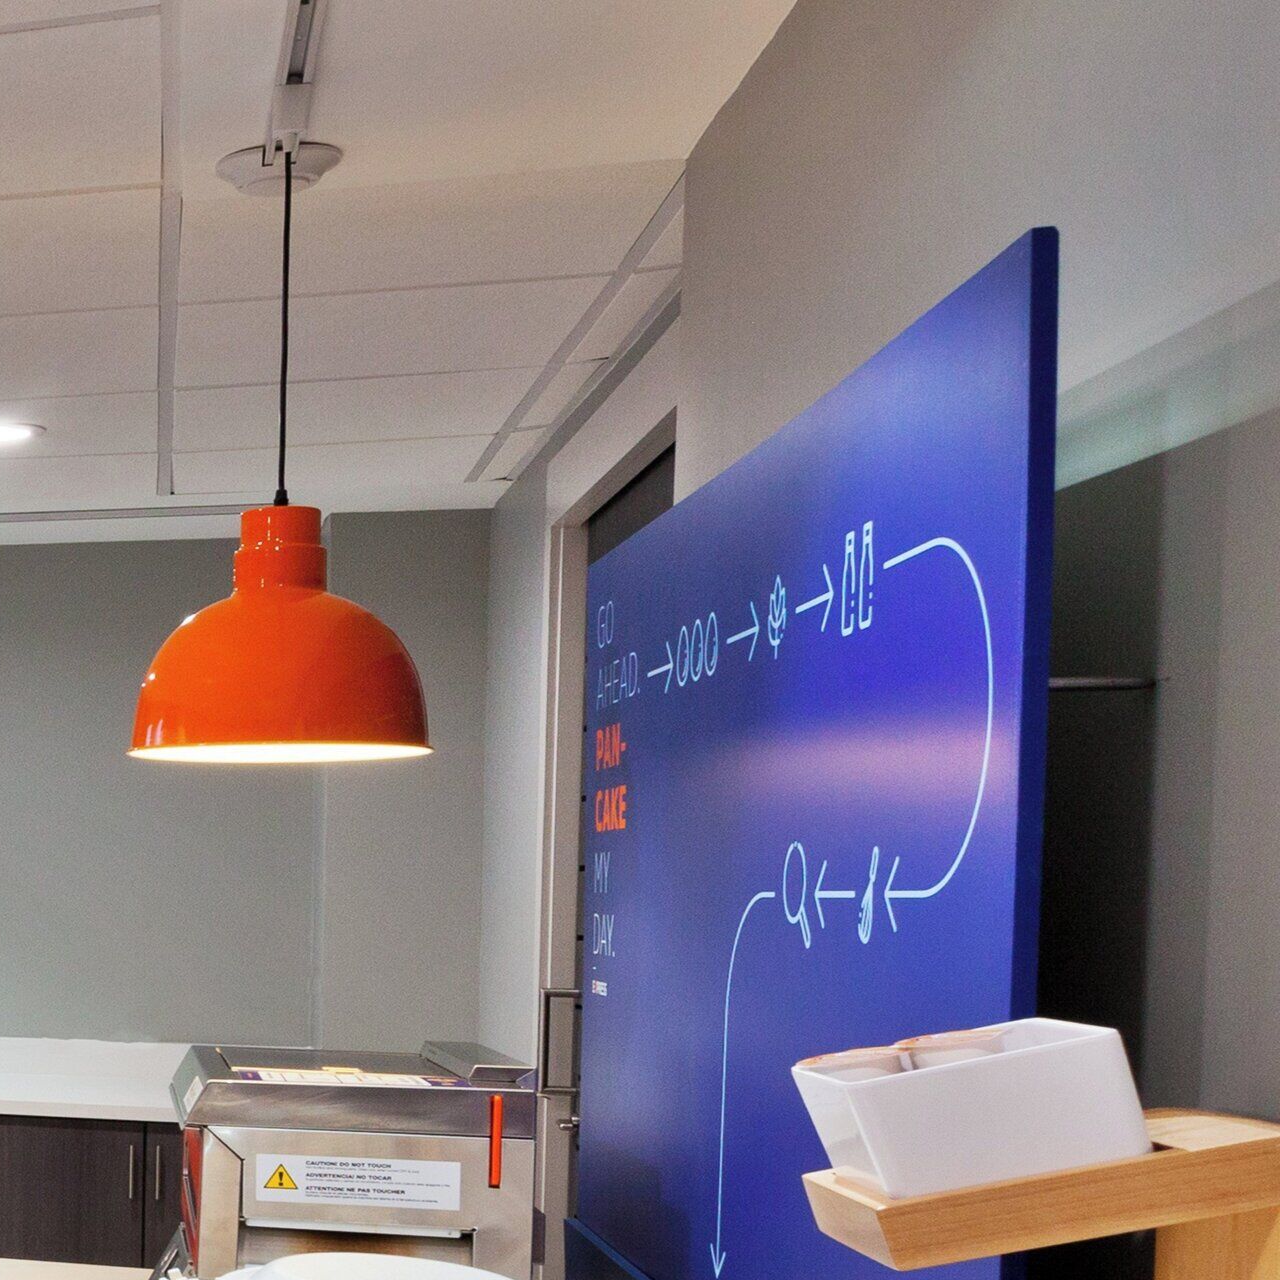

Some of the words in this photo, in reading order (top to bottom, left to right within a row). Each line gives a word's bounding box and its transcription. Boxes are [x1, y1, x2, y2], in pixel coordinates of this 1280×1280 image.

[597, 601, 614, 649] GO
[596, 652, 640, 711] AHEAD.
[596, 723, 628, 771] PAN-
[595, 785, 627, 832] CAKE
[593, 852, 611, 893] MY
